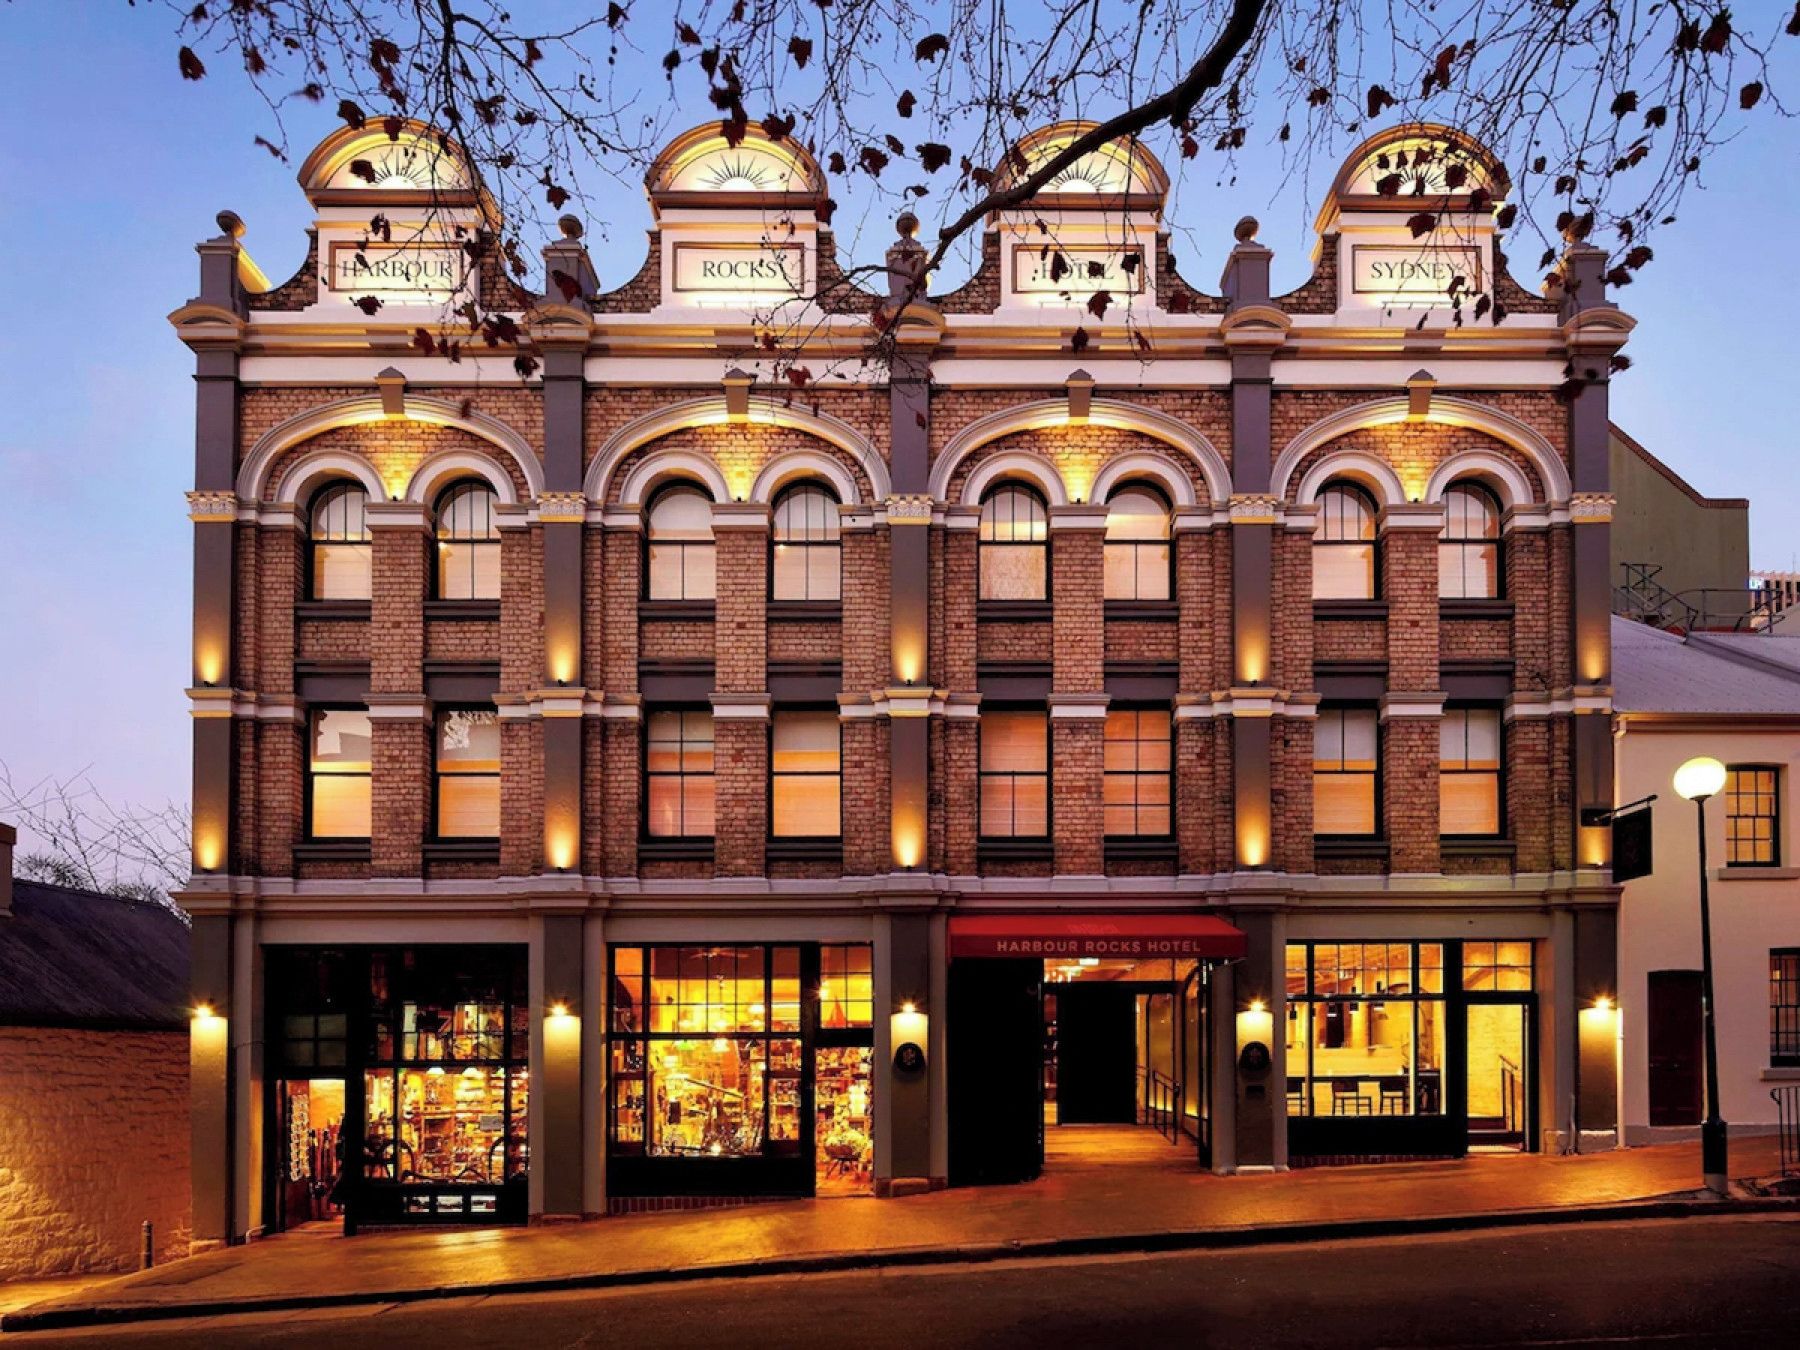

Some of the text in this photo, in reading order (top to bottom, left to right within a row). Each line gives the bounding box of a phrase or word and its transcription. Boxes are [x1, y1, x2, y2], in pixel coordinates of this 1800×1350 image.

[702, 260, 777, 278] ROCKS
[1370, 261, 1460, 280] SYDNEY
[996, 941, 1201, 952] HARBOUR ROCKS HOTEL
